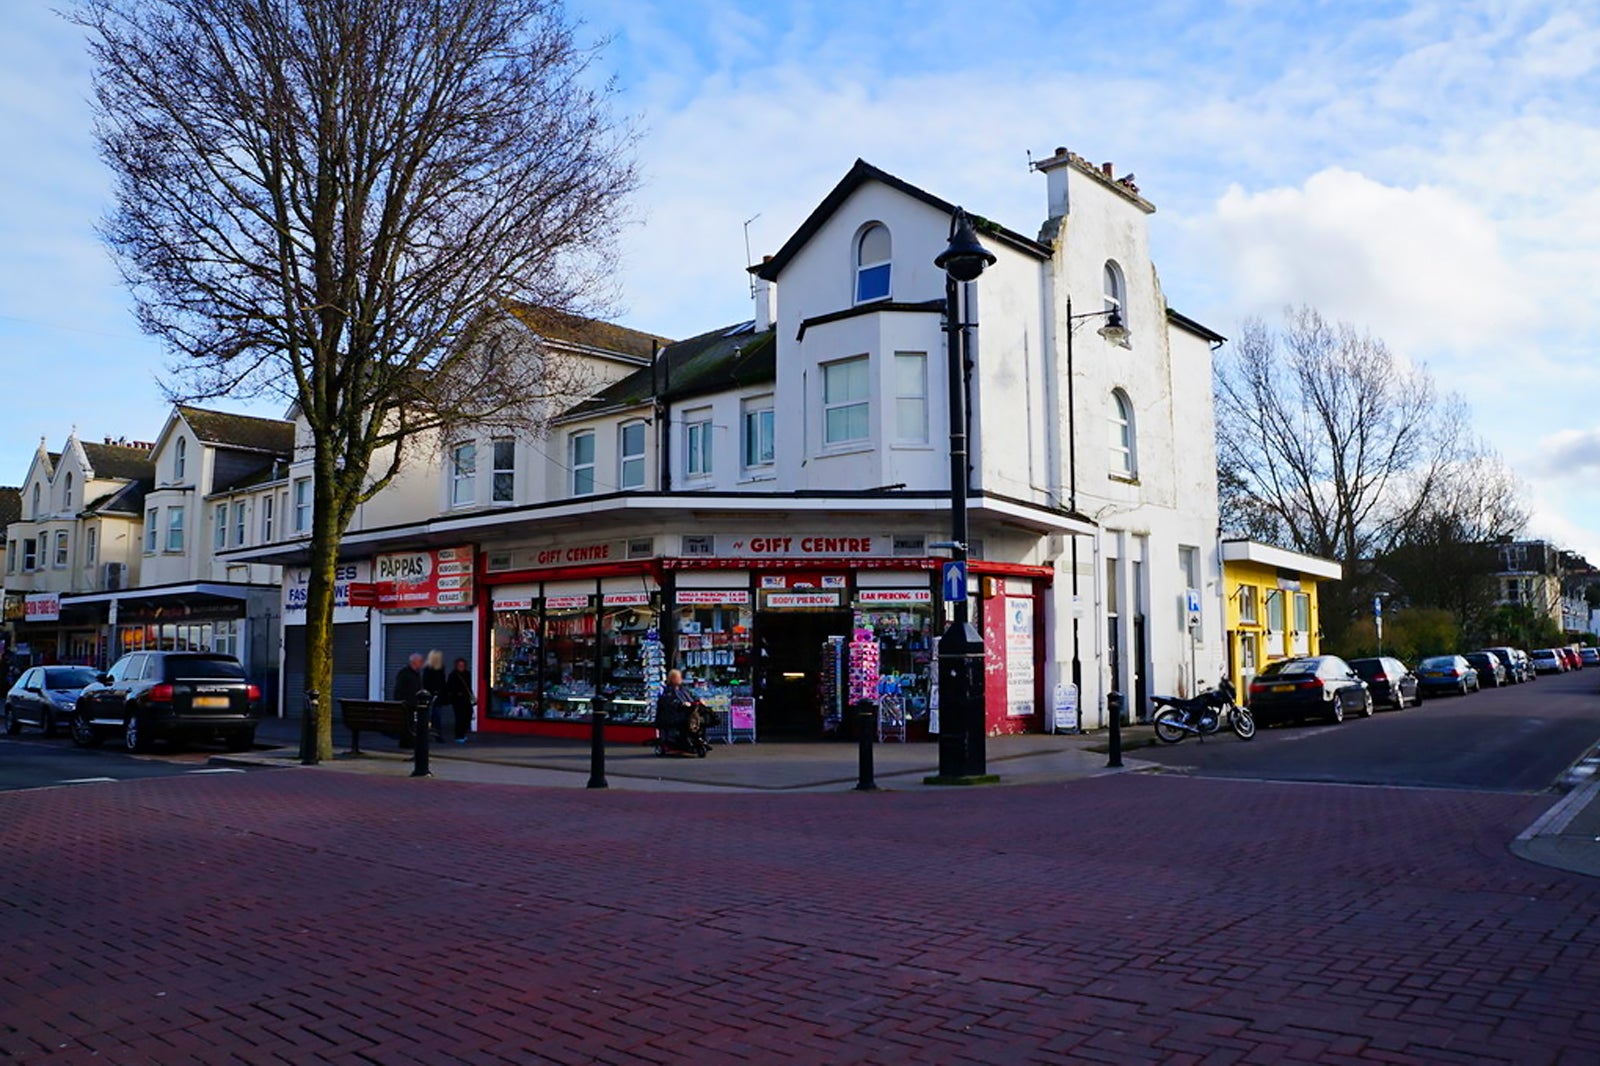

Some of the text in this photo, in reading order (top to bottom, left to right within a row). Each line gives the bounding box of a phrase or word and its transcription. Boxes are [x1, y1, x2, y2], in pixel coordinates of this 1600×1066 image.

[750, 537, 871, 552] GIFT CENTRE
[538, 545, 609, 563] GIFT CENTRE
[380, 557, 423, 576] PAPPAS
[772, 595, 835, 604] BODY PIERCING
[861, 592, 876, 600] EAR
[877, 592, 911, 600] PIERCING
